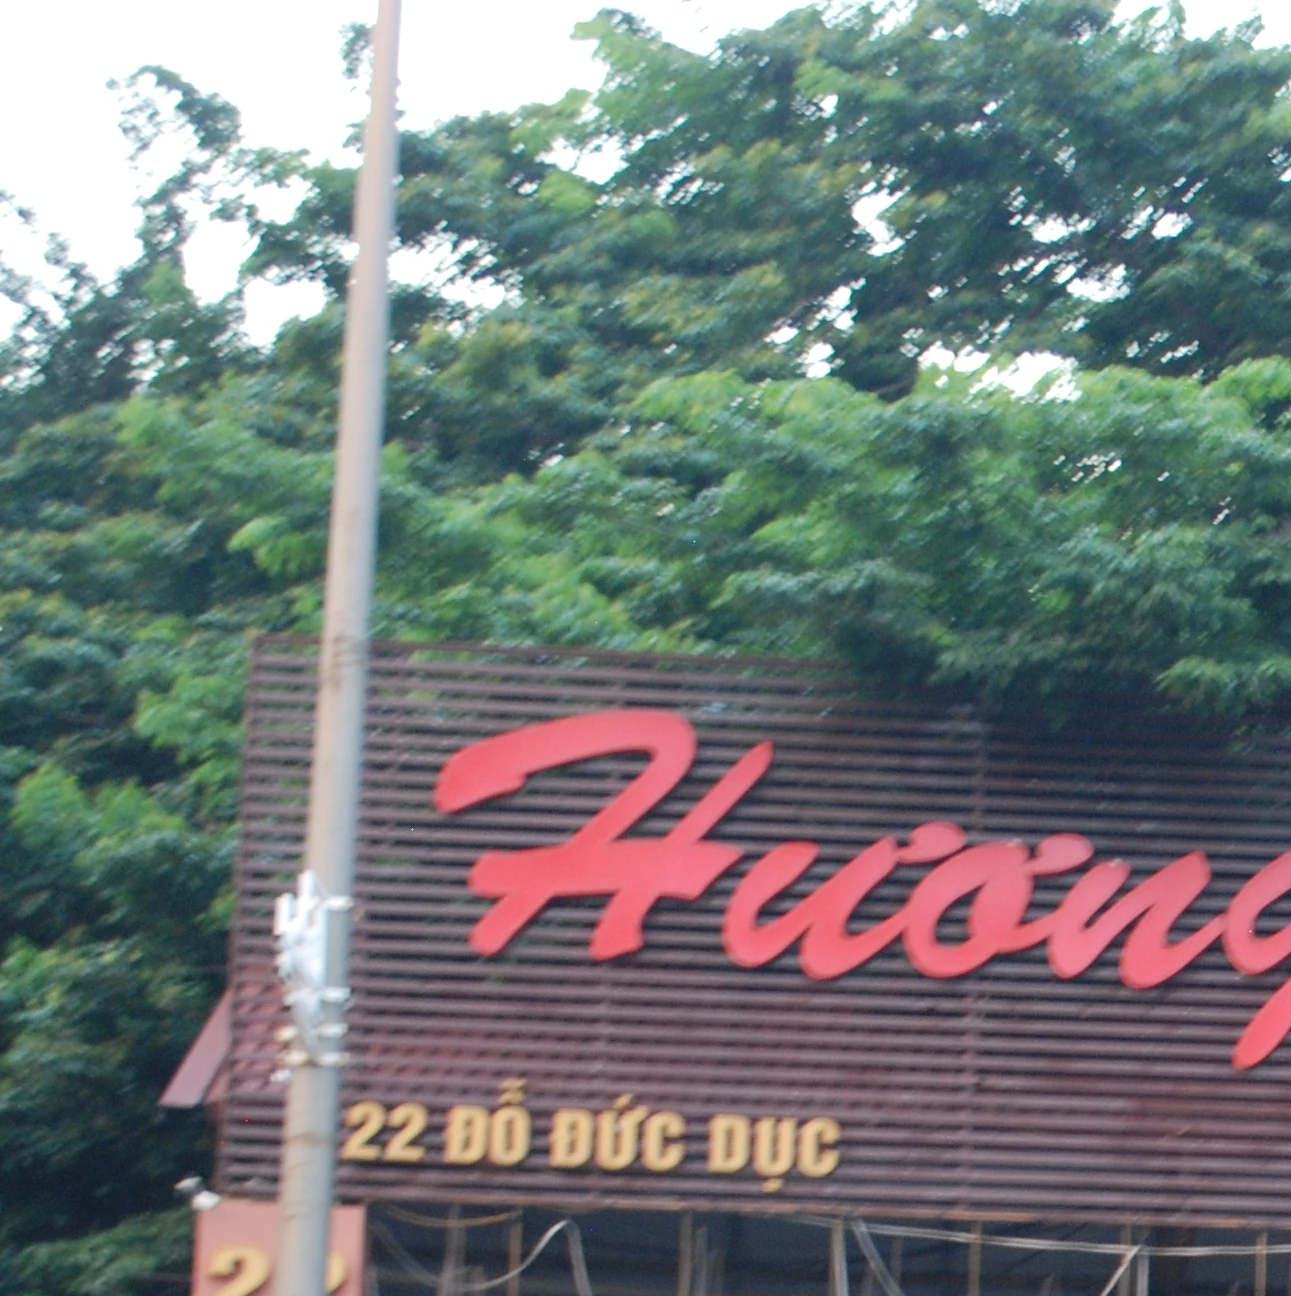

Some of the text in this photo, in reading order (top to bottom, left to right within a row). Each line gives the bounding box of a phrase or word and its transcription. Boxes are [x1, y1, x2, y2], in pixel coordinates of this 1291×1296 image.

[341, 1080, 843, 1193] 22 ĐỖ ĐỨC DỤC
